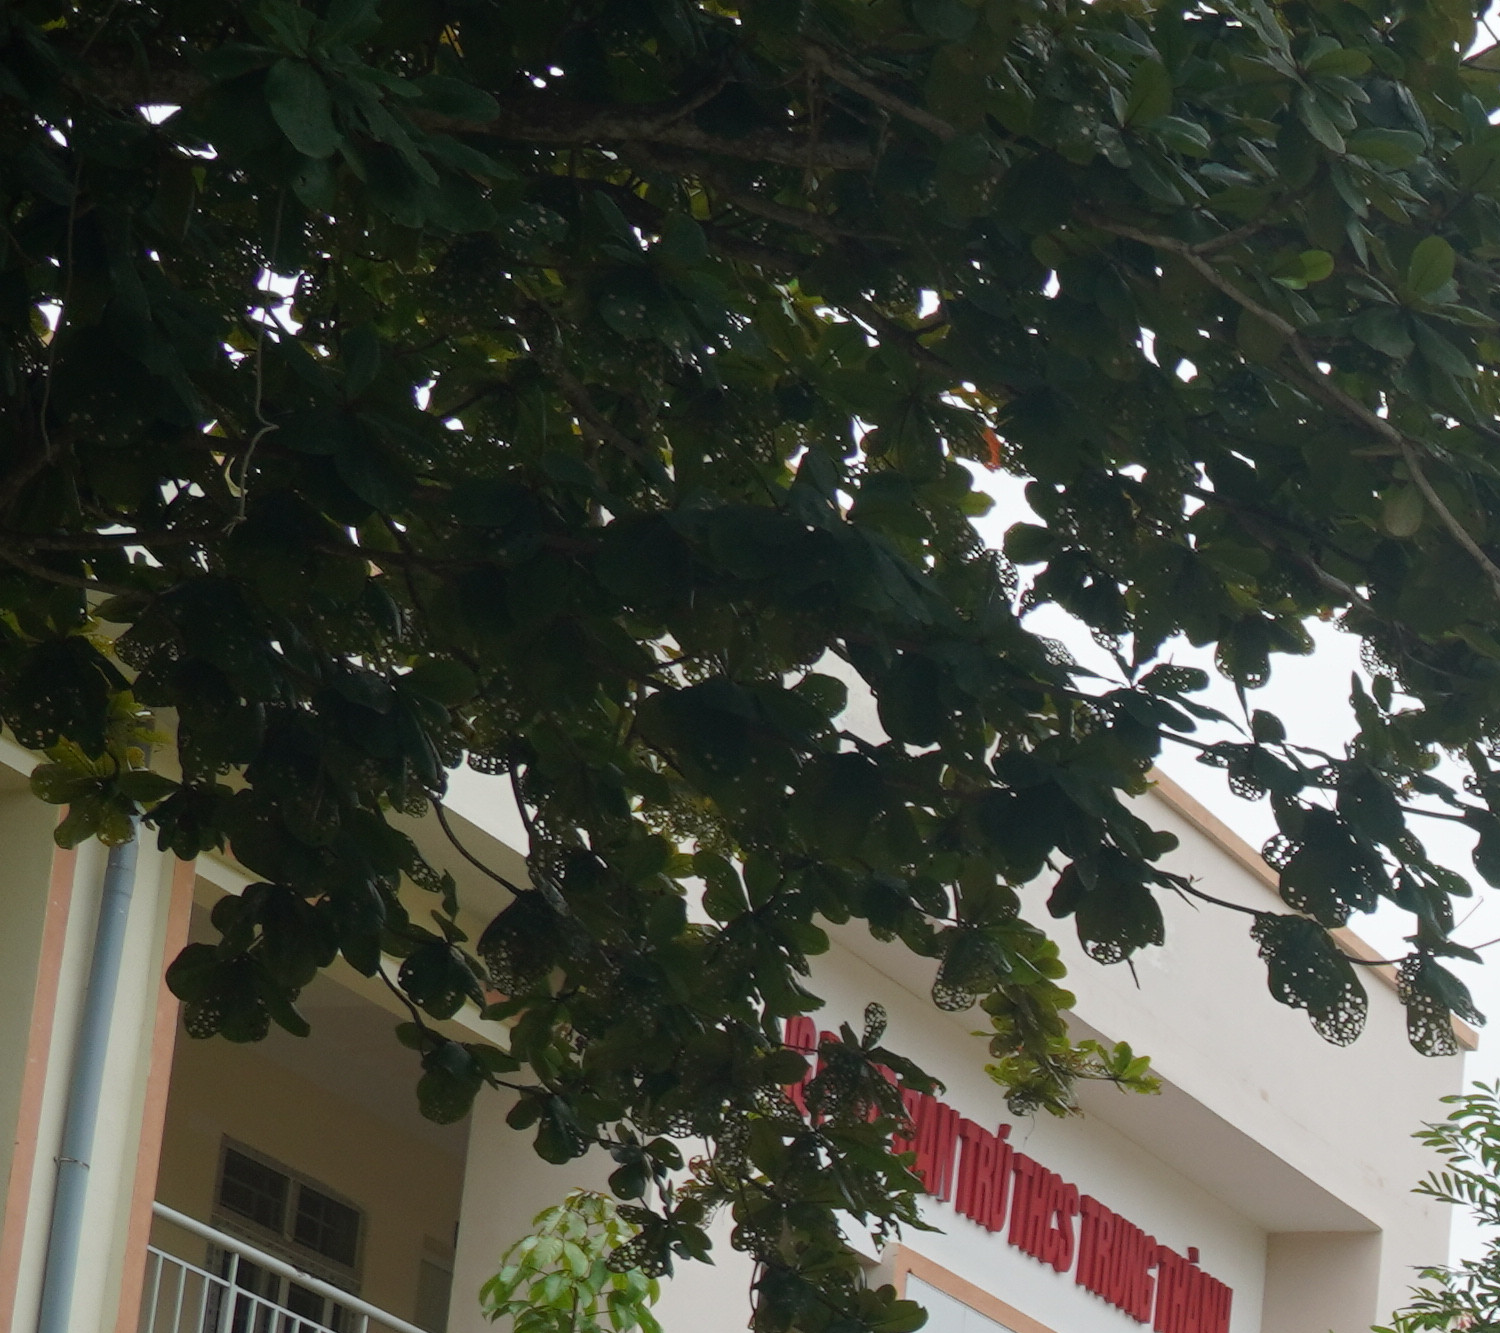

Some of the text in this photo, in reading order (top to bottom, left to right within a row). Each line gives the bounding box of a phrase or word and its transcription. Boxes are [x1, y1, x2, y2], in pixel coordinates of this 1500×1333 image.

[955, 1123, 1014, 1233] TRÚ
[1008, 1152, 1081, 1273] THCS
[1075, 1193, 1158, 1324] TRUNG
